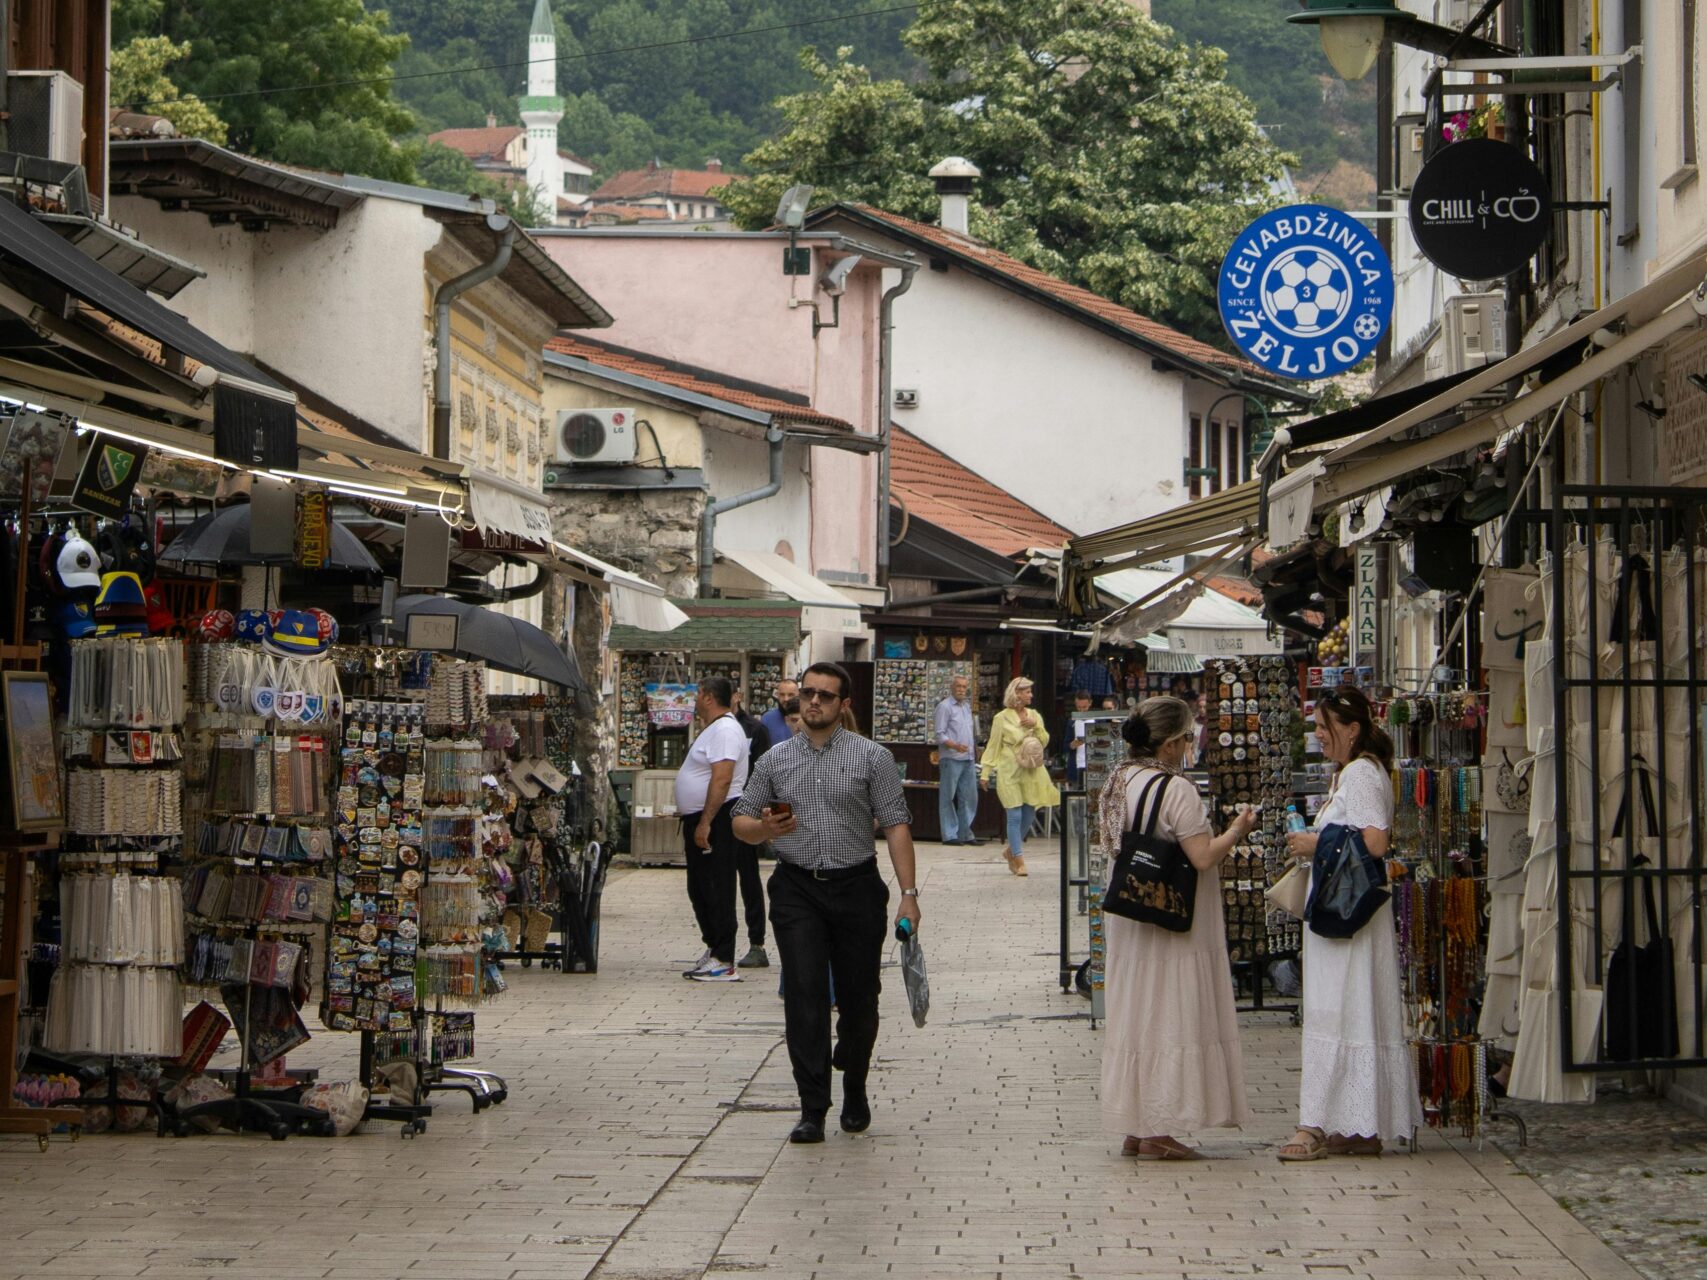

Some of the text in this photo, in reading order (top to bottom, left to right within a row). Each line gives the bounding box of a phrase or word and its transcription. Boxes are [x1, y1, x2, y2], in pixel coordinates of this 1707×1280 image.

[1422, 199, 1474, 219] CHILL
[1477, 203, 1490, 215] &
[1227, 212, 1382, 289] ĆEVABDŽINICA
[1227, 296, 1382, 307] SINCE 1968
[1302, 286, 1311, 298] 3
[1229, 309, 1359, 374] ŽELJO
[303, 493, 323, 567] SARAJEVO
[1360, 554, 1375, 645] ZLATAR
